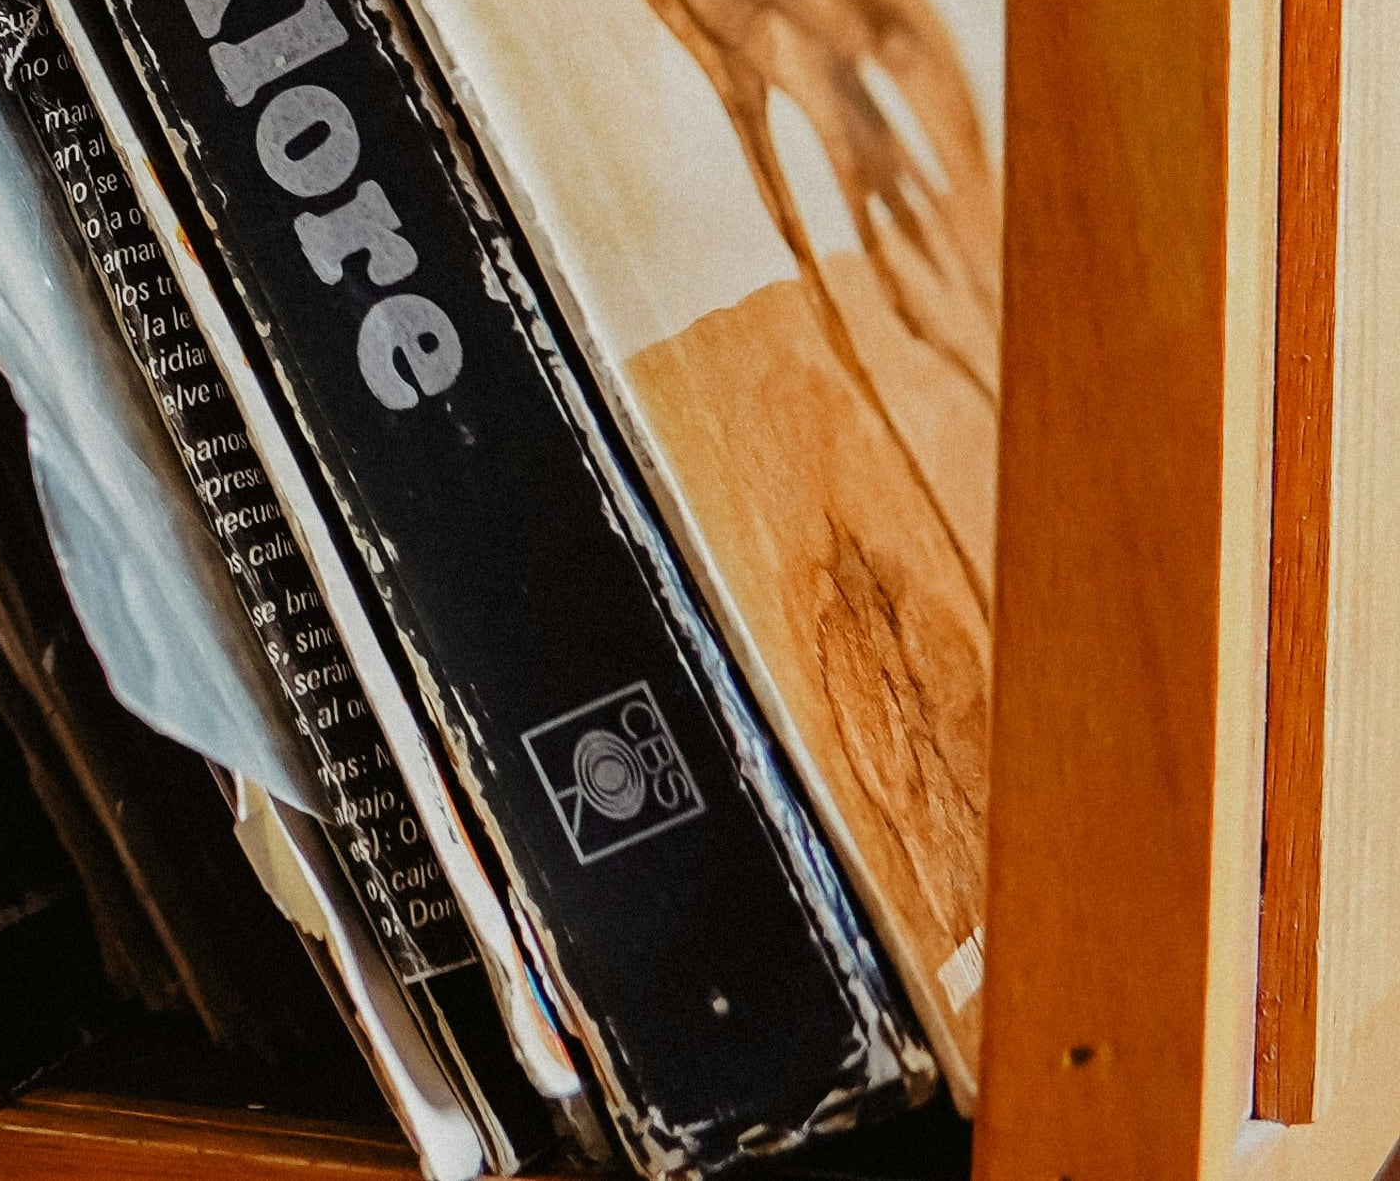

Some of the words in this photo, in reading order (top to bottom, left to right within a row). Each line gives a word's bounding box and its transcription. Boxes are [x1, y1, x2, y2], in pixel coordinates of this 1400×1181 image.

[96, 172, 118, 194] se
[114, 281, 151, 314] los
[621, 700, 691, 810] CBS
